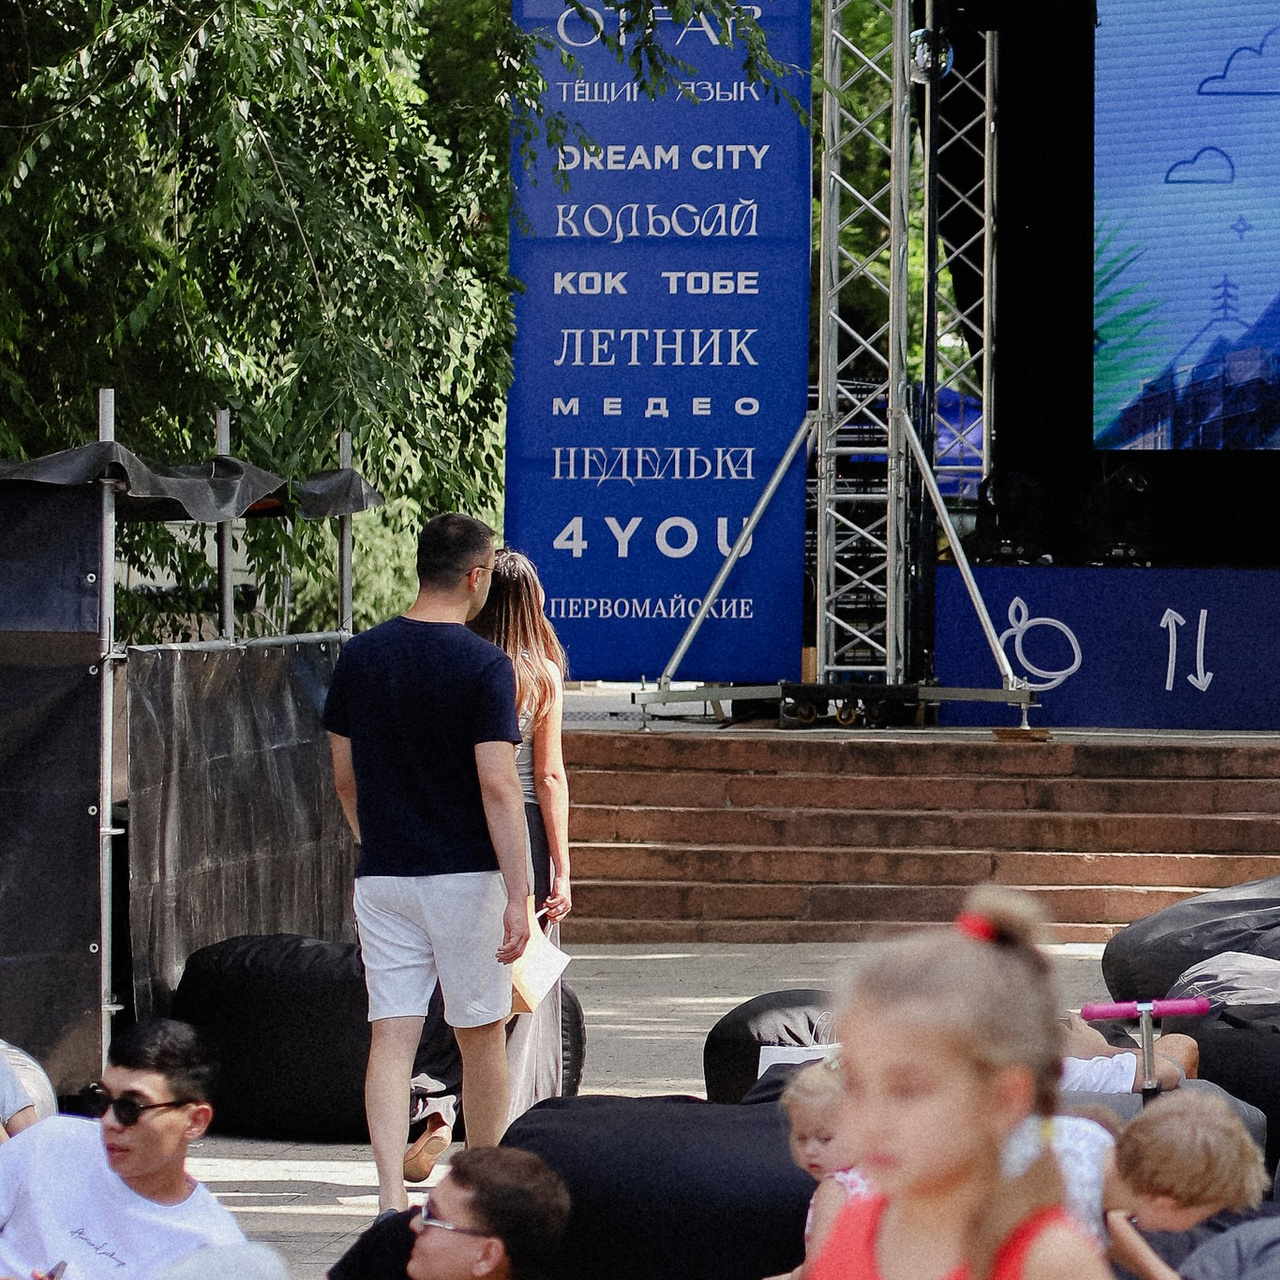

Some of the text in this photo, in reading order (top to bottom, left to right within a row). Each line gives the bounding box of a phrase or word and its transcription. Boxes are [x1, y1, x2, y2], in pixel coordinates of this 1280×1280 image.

[558, 145, 770, 170] DREAM CITY
[555, 197, 759, 243] КОЛЬСАЙ
[554, 271, 760, 295] КОК ТОБЕ
[553, 328, 759, 366] ЛЕТНИК
[552, 397, 760, 418] МЕДЕО
[551, 447, 757, 487] НЕДЕЛЬКА
[552, 516, 753, 558] 4YOU
